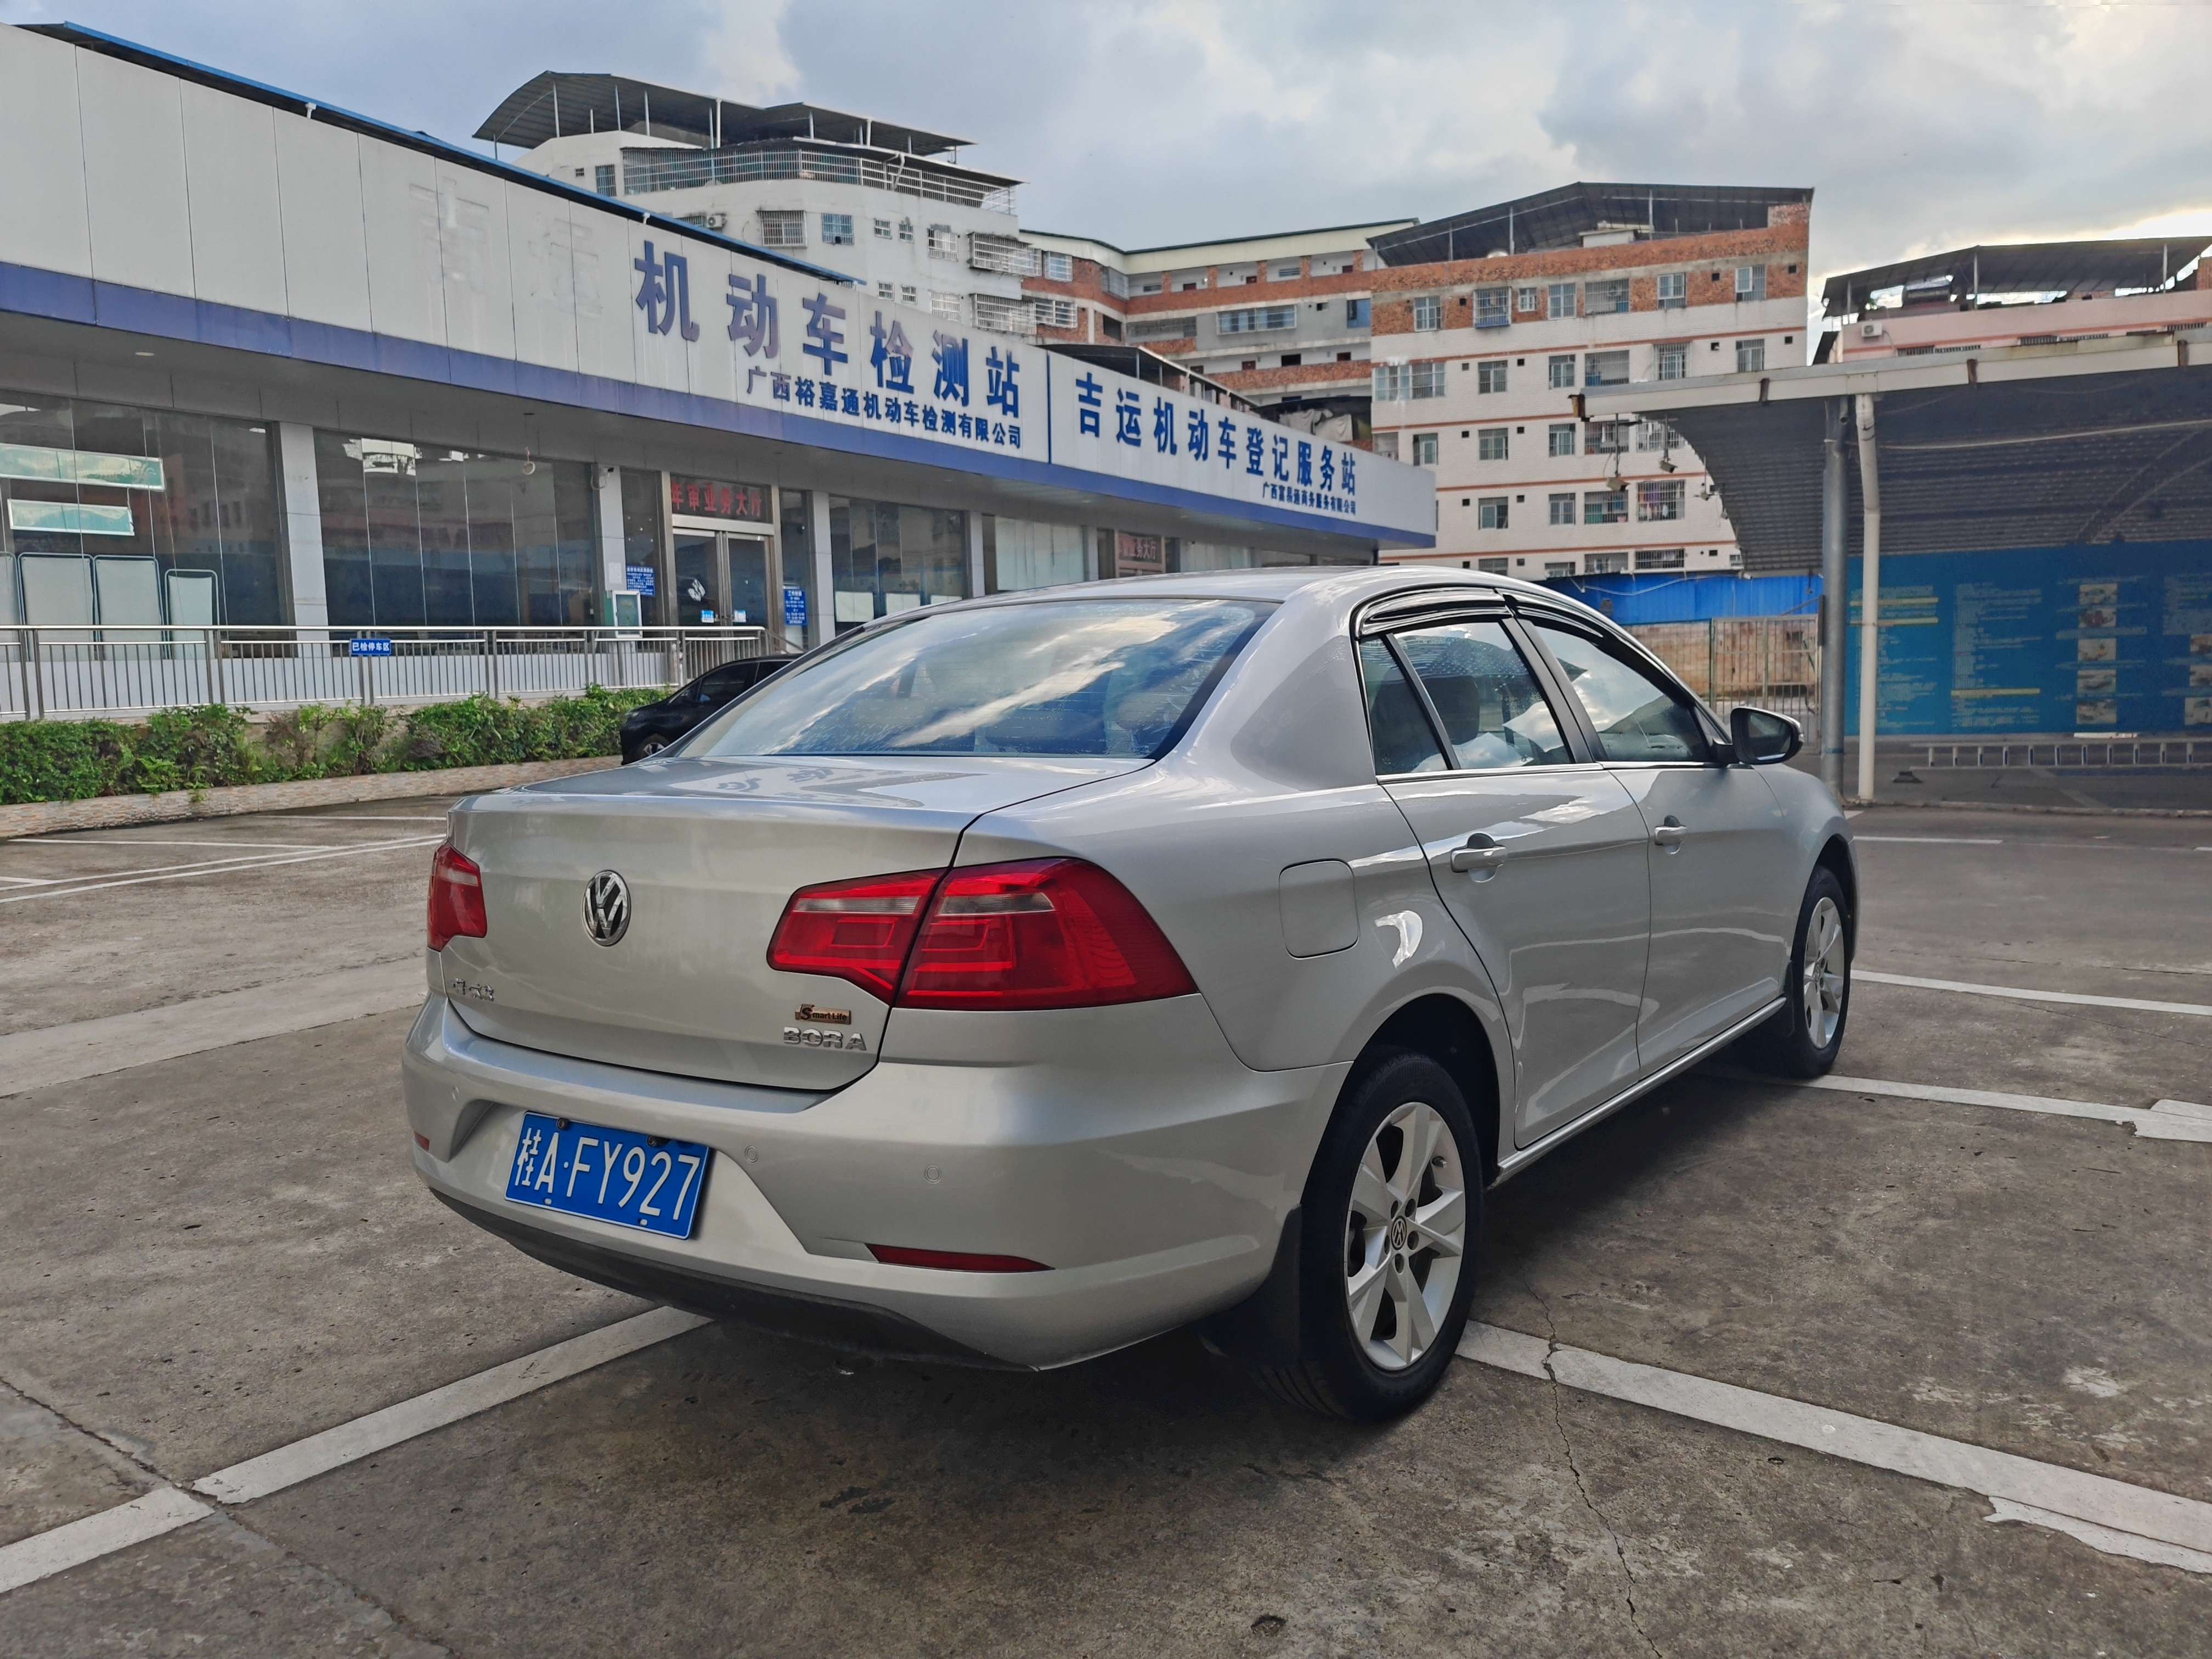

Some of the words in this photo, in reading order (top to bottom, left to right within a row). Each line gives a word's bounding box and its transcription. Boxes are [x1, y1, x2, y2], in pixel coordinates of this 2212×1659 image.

[635, 240, 1020, 418] 机动车检测站
[747, 366, 1021, 449] 广西裕嘉通机动车检测有限公司
[1076, 372, 1356, 496] 吉运机动车登记服务站
[352, 642, 390, 651] 已检停车区
[783, 1026, 867, 1051] BORA
[800, 1007, 831, 1020] Smart
[832, 1013, 848, 1021] Life
[515, 1127, 701, 1221] 桂A·FY927
